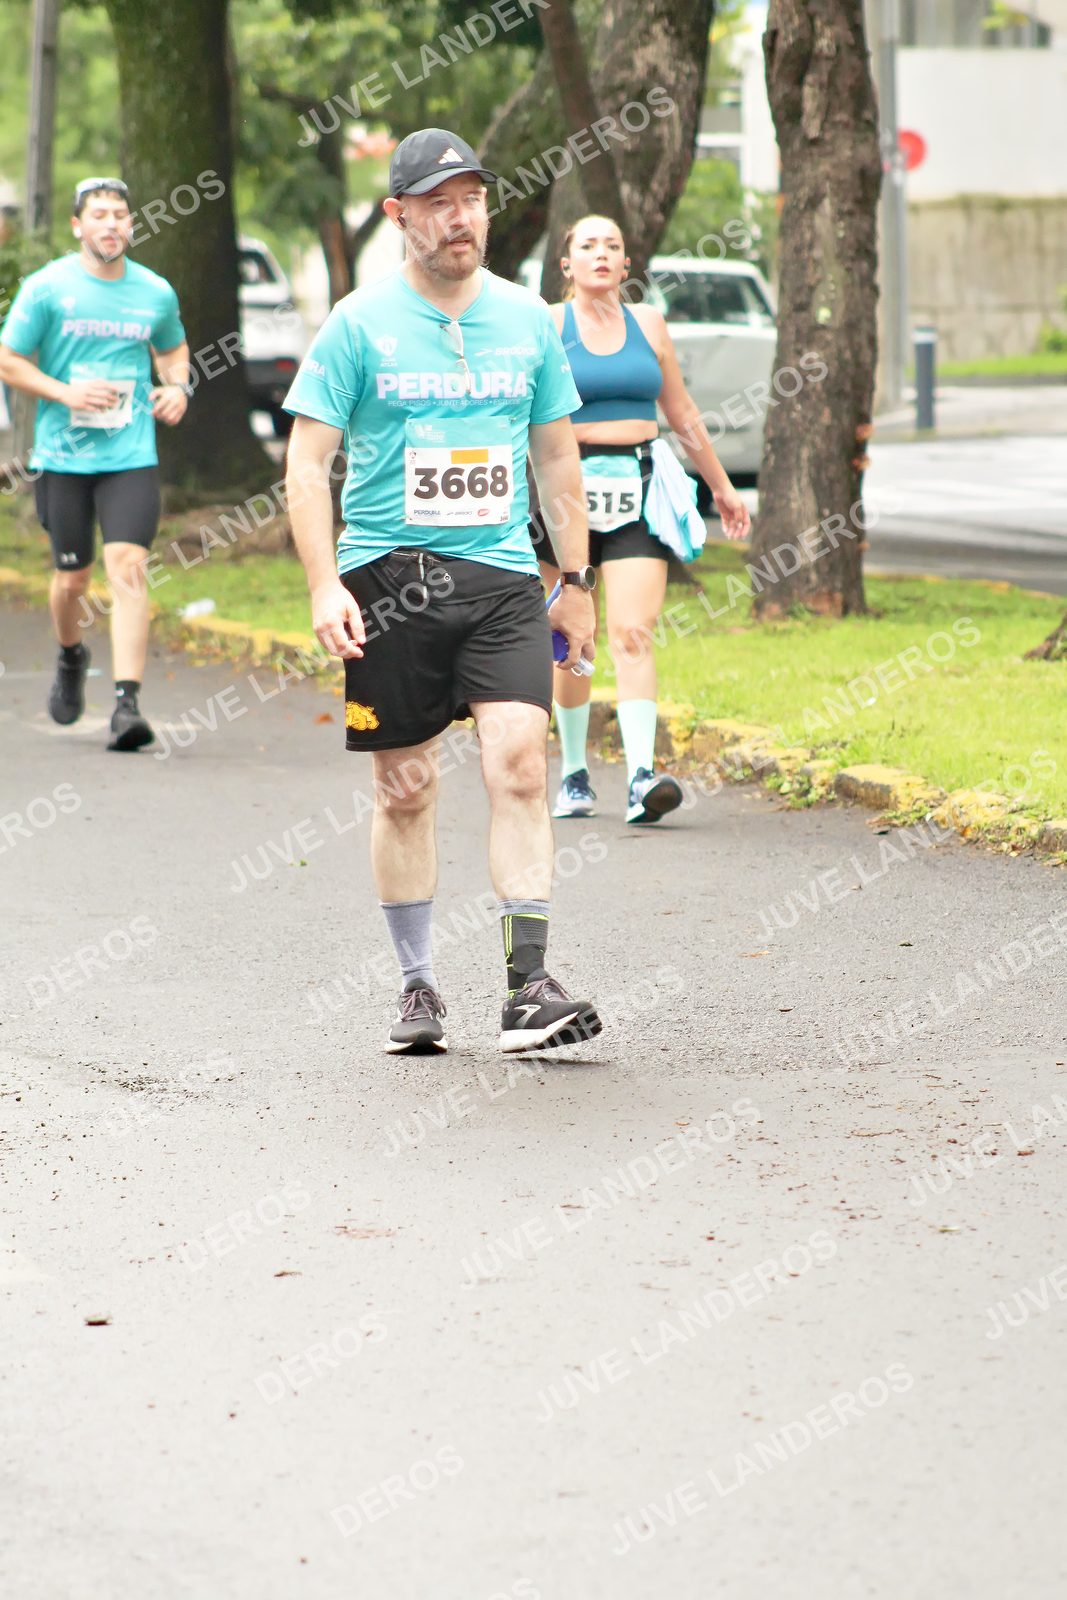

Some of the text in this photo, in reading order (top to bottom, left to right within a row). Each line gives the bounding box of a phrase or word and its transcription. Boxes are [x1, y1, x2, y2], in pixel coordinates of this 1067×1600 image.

[61, 319, 151, 341] PERDURA
[376, 372, 528, 399] PERDURA
[414, 465, 509, 499] 3668
